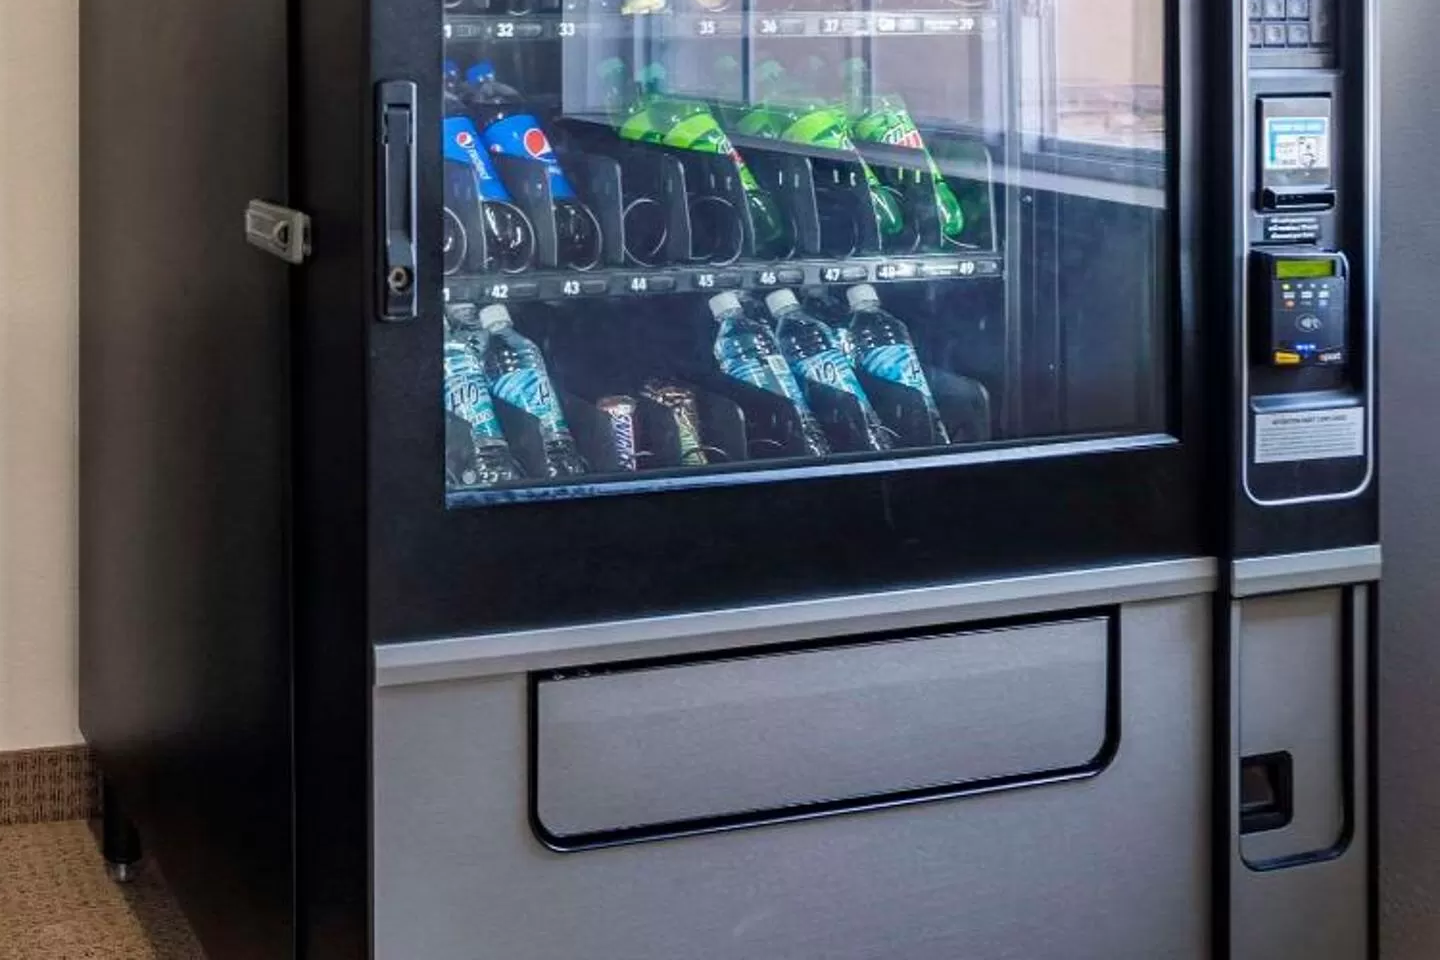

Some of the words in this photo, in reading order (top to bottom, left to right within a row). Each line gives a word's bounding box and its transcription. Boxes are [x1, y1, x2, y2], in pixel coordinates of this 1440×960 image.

[497, 24, 513, 38] 32
[559, 22, 575, 36] 33
[699, 21, 715, 35] 35
[762, 19, 777, 33] 36
[824, 18, 839, 32] 37
[960, 18, 974, 30] 39
[825, 268, 840, 281] 47
[960, 262, 974, 274] 49
[631, 277, 647, 290] 44
[699, 274, 714, 287] 45
[761, 271, 776, 285] 46
[492, 285, 509, 298] 42
[564, 280, 580, 294] 43
